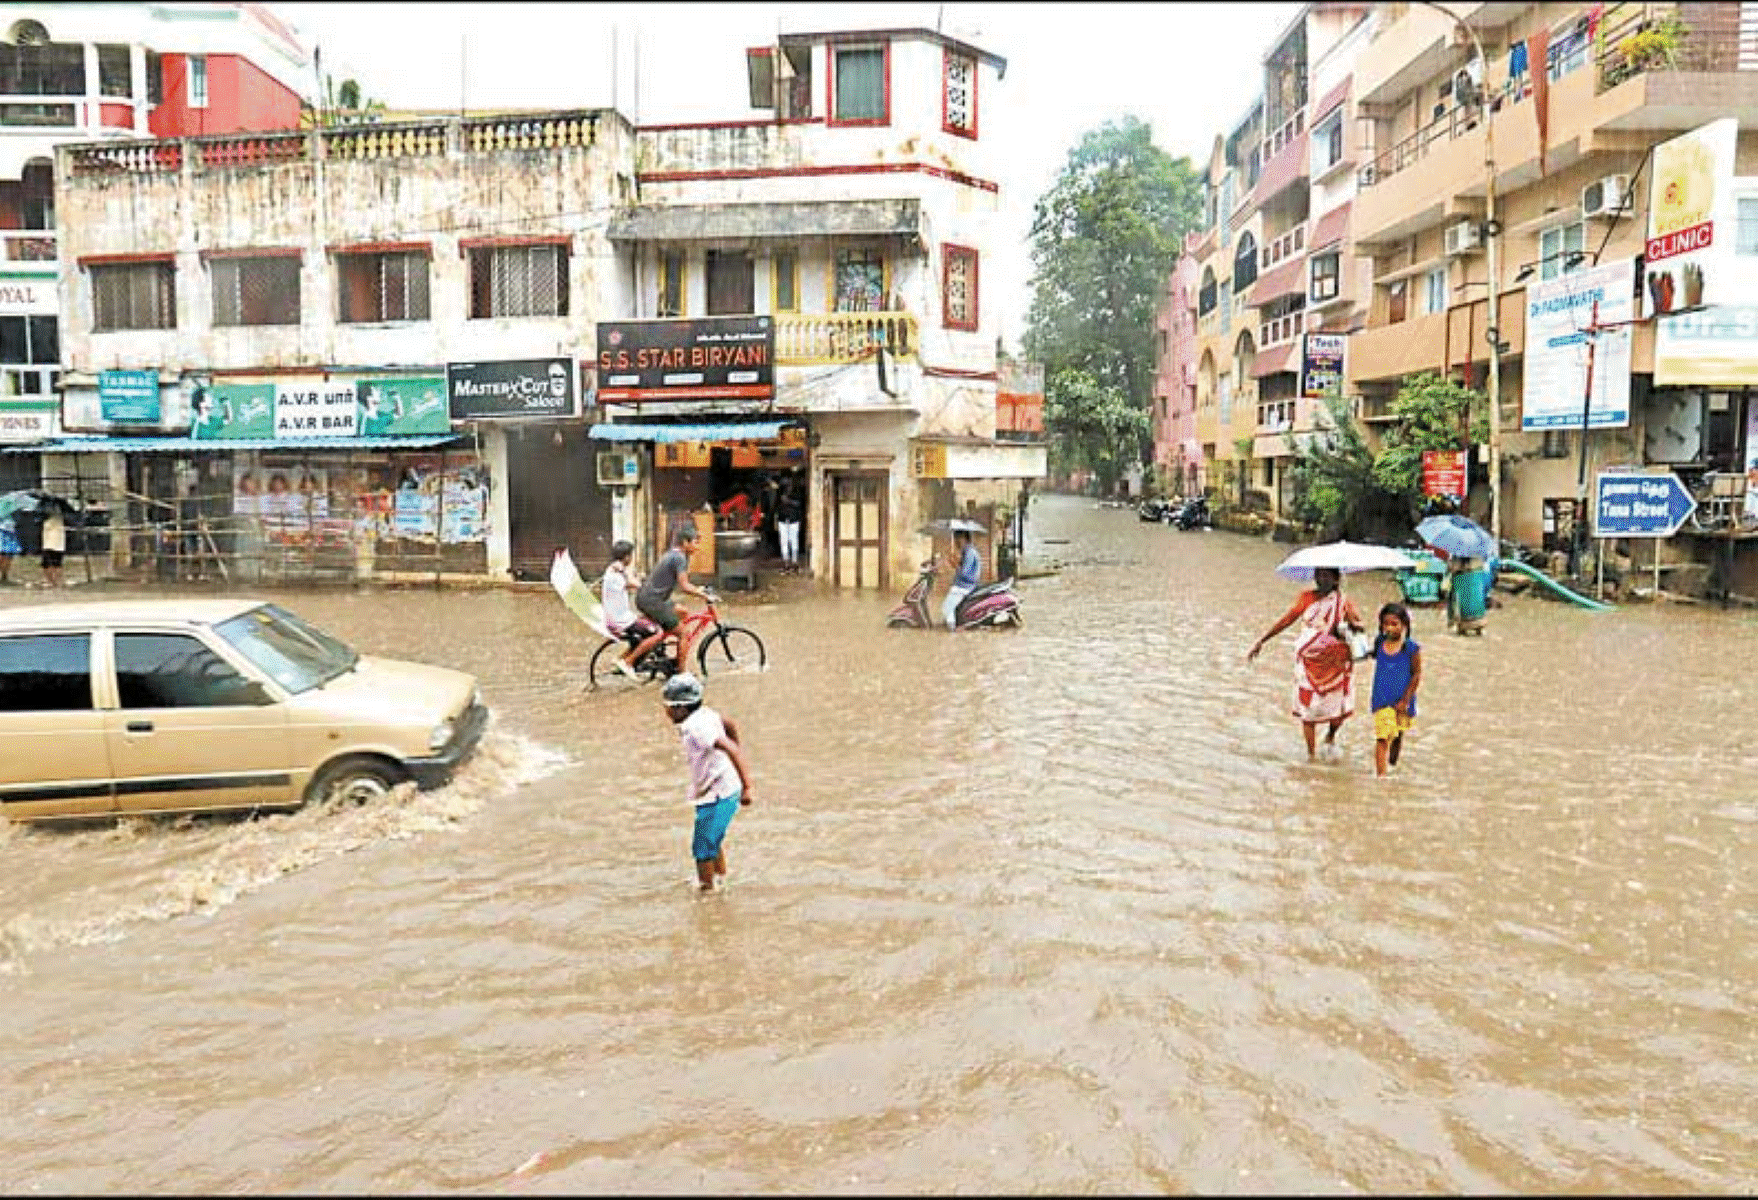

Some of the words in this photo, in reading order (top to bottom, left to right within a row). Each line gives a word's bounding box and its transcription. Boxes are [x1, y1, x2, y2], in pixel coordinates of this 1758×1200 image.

[1649, 227, 1710, 259] CLINIC
[0, 286, 35, 303] YAL
[600, 350, 635, 370] S.S.
[637, 347, 685, 368] STAR
[691, 344, 767, 366] BIRYANI
[279, 392, 318, 405] A.V.R
[279, 417, 317, 429] A.V.R
[322, 415, 353, 428] BAR
[1633, 501, 1668, 517] Street
